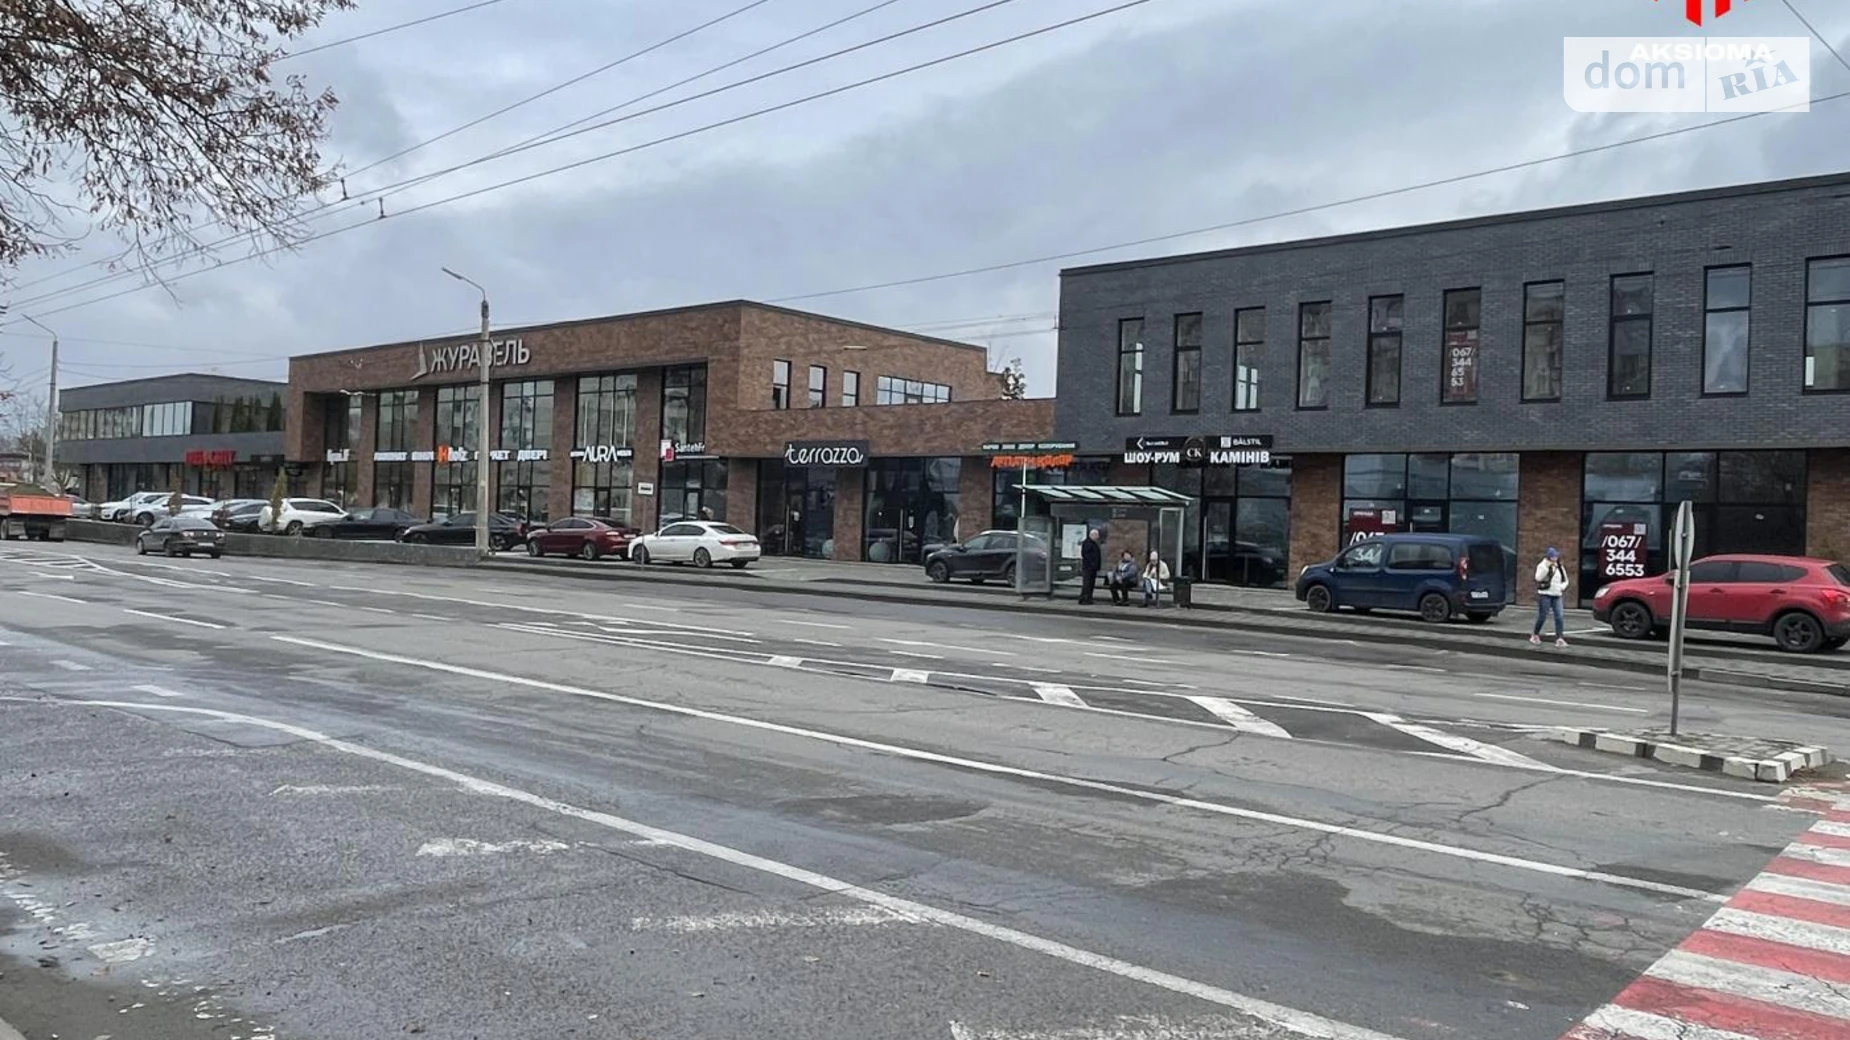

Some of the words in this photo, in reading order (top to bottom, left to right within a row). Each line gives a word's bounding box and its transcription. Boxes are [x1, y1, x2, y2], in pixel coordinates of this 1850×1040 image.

[583, 445, 618, 462] AURA
[1124, 451, 1180, 463] ШОУ-РУМ
[1210, 450, 1270, 463] КАМІНІВ
[1601, 534, 1642, 548] /067/
[1606, 548, 1637, 562] 344
[1605, 562, 1645, 577] 6553
